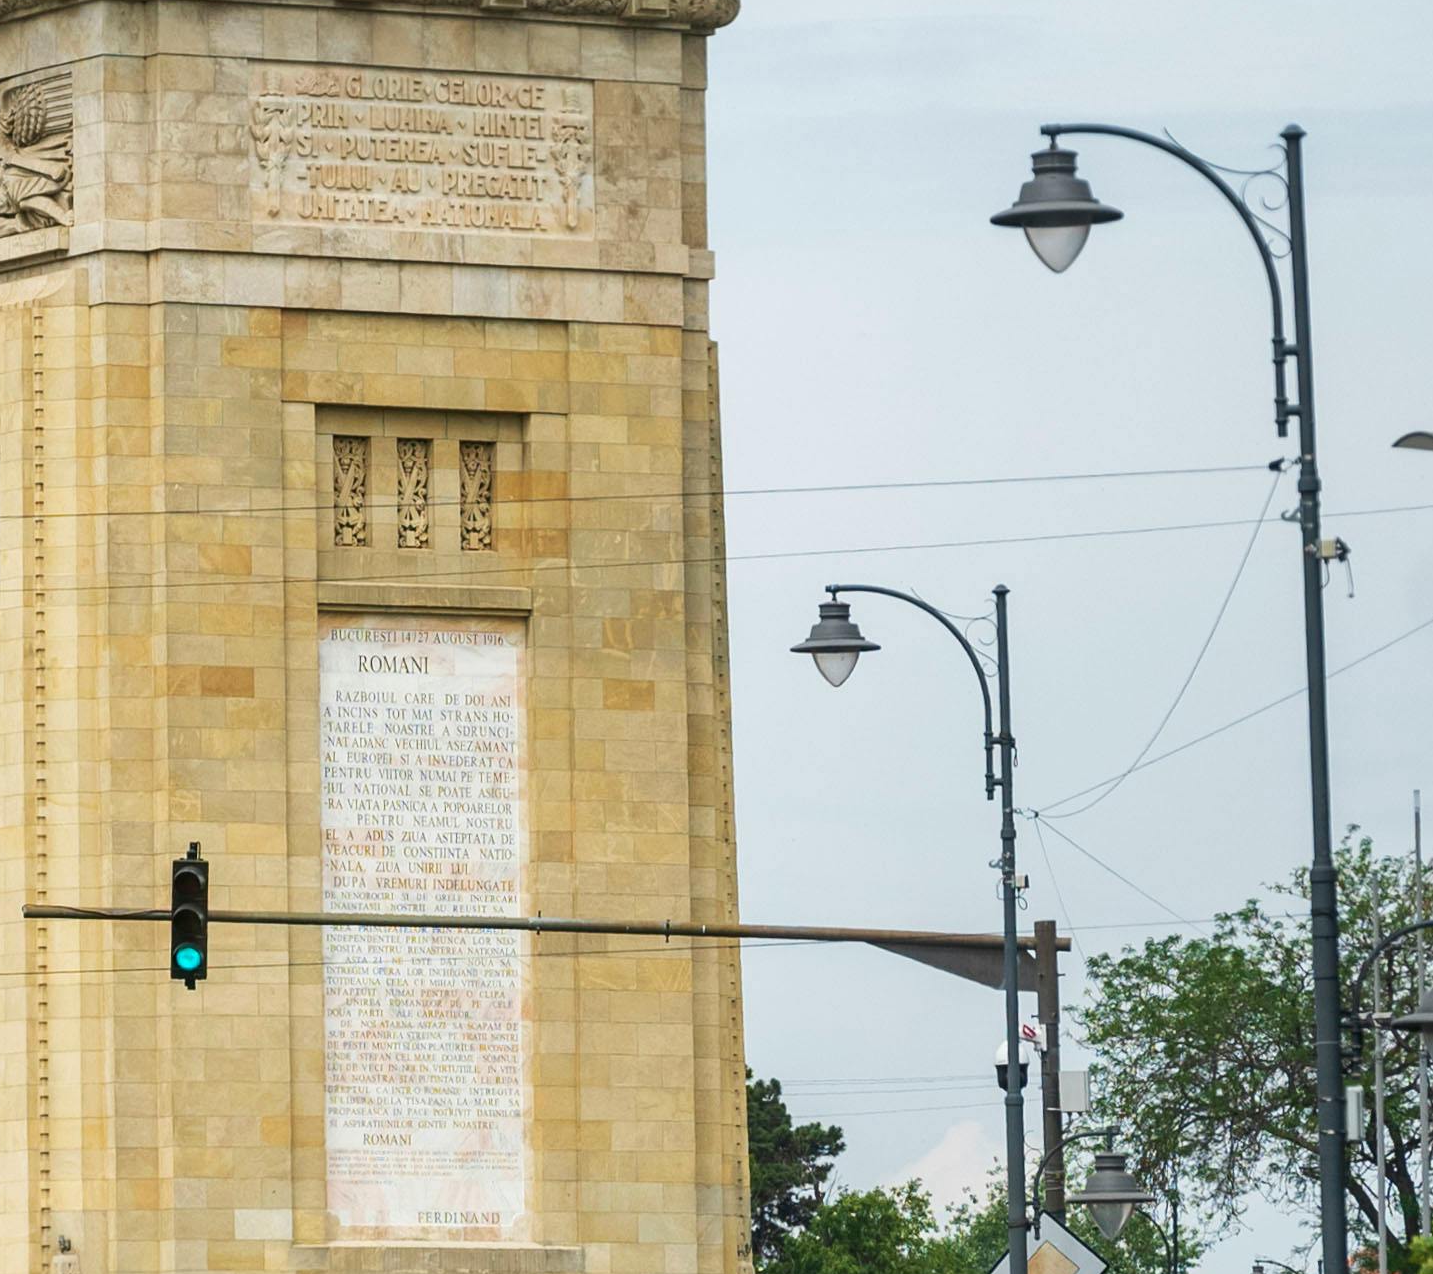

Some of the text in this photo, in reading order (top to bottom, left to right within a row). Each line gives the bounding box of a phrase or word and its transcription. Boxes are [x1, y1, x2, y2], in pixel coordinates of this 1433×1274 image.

[345, 76, 545, 111] GLORIE CELOR CE
[296, 101, 349, 129] PRIN
[296, 133, 319, 159] SI
[340, 134, 445, 165] PUTEREA
[390, 168, 422, 194] AU
[358, 655, 428, 674] ROMANI
[336, 690, 511, 707] RAZBOIUL CARE DE DOI ANI
[323, 707, 331, 717] A
[338, 706, 378, 718] INCINS
[386, 708, 407, 719] TOT
[411, 709, 433, 720] MAI
[440, 709, 488, 722] STRANS
[385, 723, 435, 735] NOASTRE
[443, 725, 450, 736] A
[324, 766, 371, 779] PENTRU
[378, 768, 413, 781] VIITOR
[420, 770, 457, 782] NUMAI
[461, 771, 473, 782] PE
[353, 783, 411, 796] NATIONAL
[419, 785, 432, 797] SE
[438, 785, 472, 798] POATE
[347, 798, 380, 810] VIATA
[383, 799, 427, 812] PASNICA
[430, 801, 438, 812] A
[443, 801, 512, 814] POPOARELOR
[333, 876, 515, 892] DUPA VREMURI INDELUNGATE
[363, 1133, 412, 1146] ROMANI
[417, 1211, 501, 1224] FERDINAND
